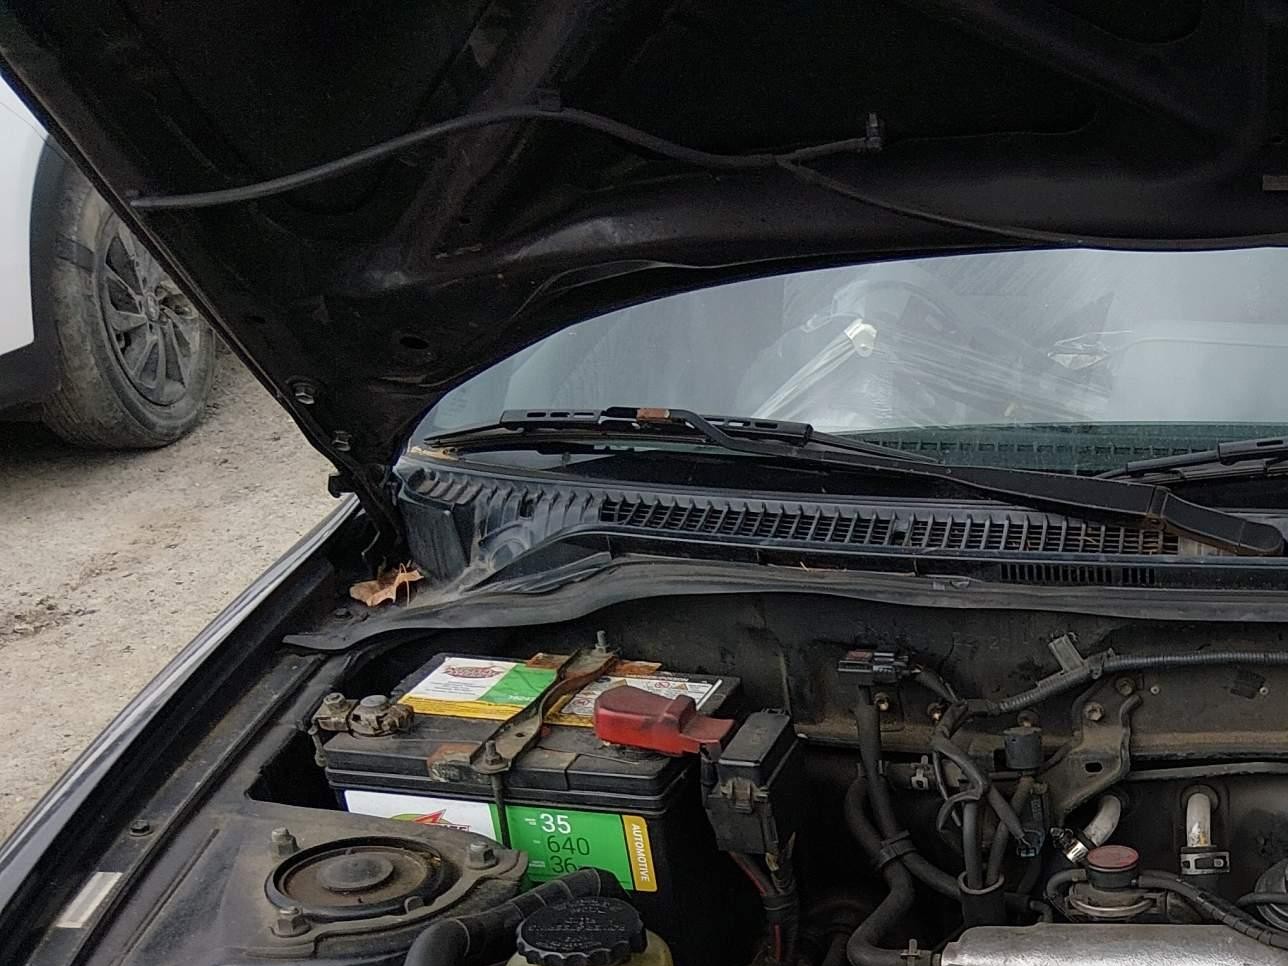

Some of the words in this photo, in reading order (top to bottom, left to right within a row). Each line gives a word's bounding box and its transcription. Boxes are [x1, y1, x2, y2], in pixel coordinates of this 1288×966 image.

[540, 813, 571, 834] 35
[547, 835, 590, 856] 640
[631, 823, 650, 882] AUTOMOTIVE
[549, 855, 577, 873] 36
